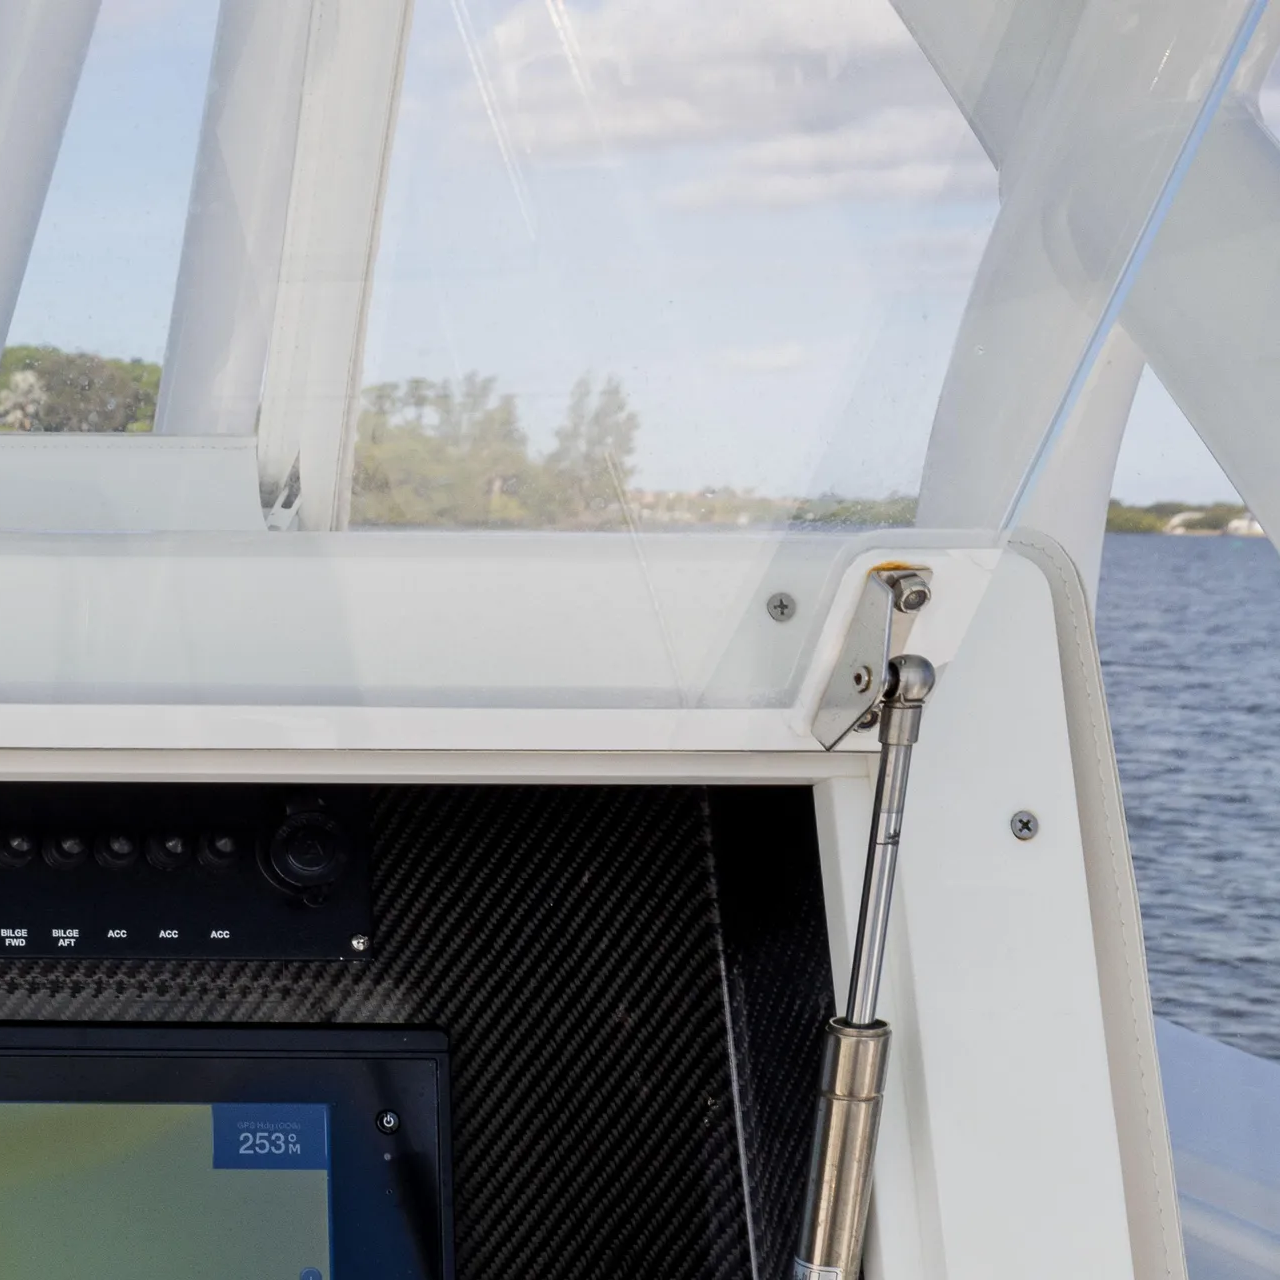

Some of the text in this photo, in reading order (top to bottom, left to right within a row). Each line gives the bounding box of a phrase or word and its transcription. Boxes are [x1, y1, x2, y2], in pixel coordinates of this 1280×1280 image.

[52, 929, 79, 937] BILGE
[159, 930, 178, 938] ACC
[238, 1132, 286, 1154] 253
